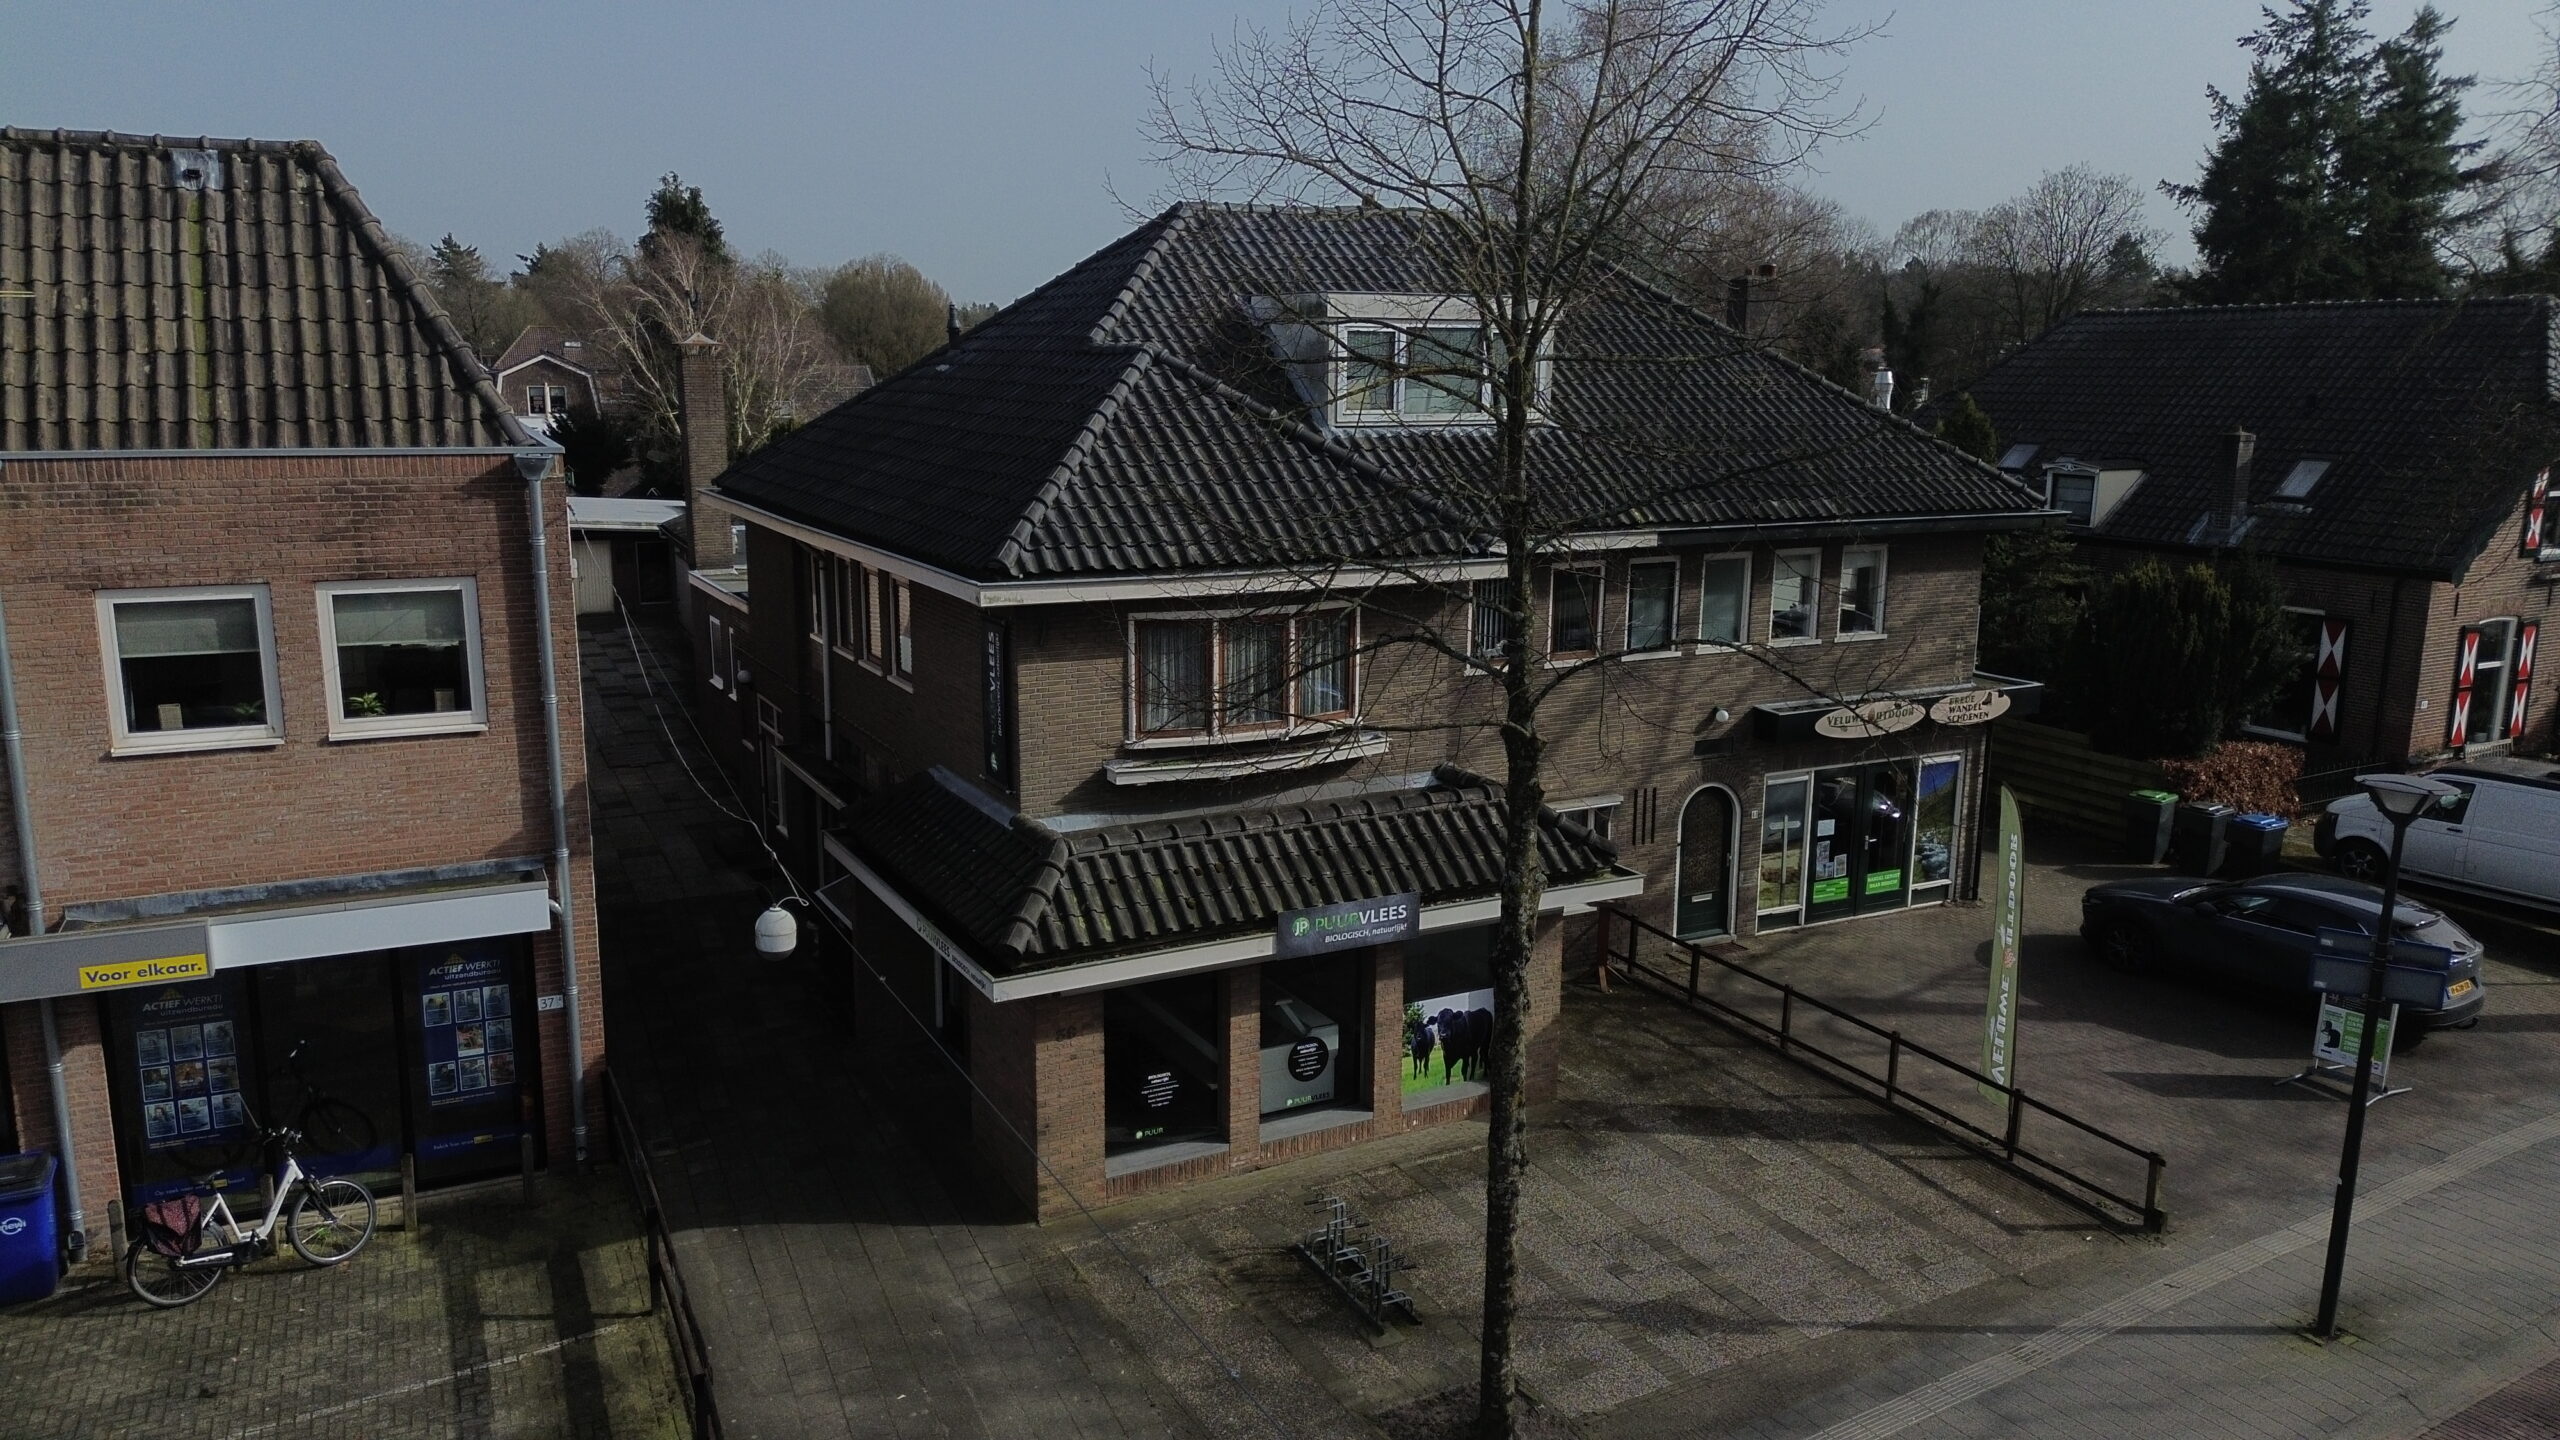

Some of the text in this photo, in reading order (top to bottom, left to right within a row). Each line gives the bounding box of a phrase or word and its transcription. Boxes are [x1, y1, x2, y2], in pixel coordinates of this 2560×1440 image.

[1949, 703, 1983, 714] WANDEL
[1826, 713, 1868, 726] VELUWE
[1947, 711, 1990, 723] SCHOENEN
[1315, 904, 1407, 931] PUURVLEES
[1324, 923, 1408, 943] BIOLOGISCH, natuurlijk!
[85, 962, 202, 983] Voor elkaar.
[428, 963, 463, 977] ACTIEF
[444, 968, 501, 981] uitzendbureau
[142, 1000, 182, 1012] ACTIEF
[160, 1003, 224, 1016] uitzendbureau
